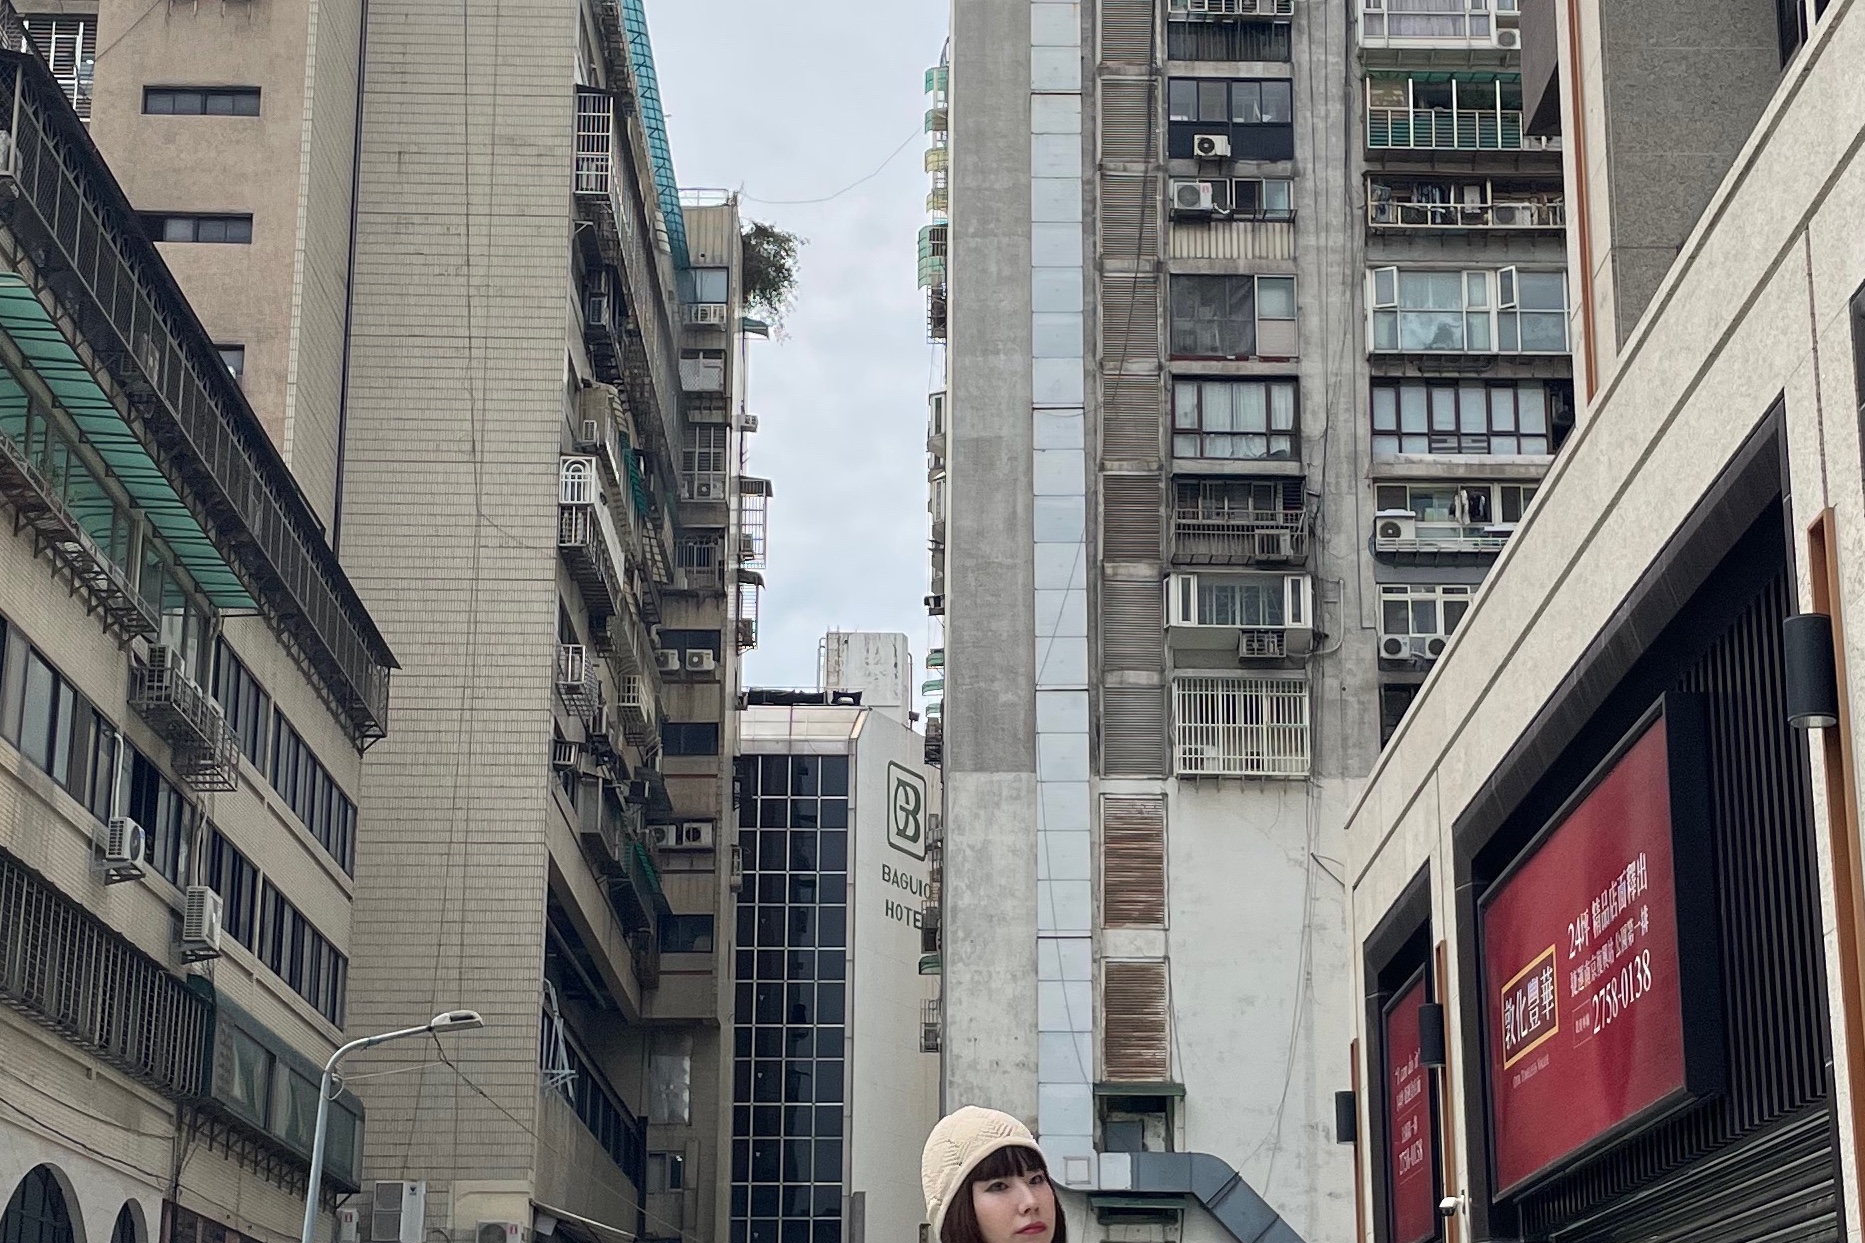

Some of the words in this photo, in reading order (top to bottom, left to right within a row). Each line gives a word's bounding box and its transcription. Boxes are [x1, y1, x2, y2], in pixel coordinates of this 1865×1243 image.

[1504, 965, 1555, 1051] 敦化豐華
[1592, 948, 1651, 1034] 2758-0138
